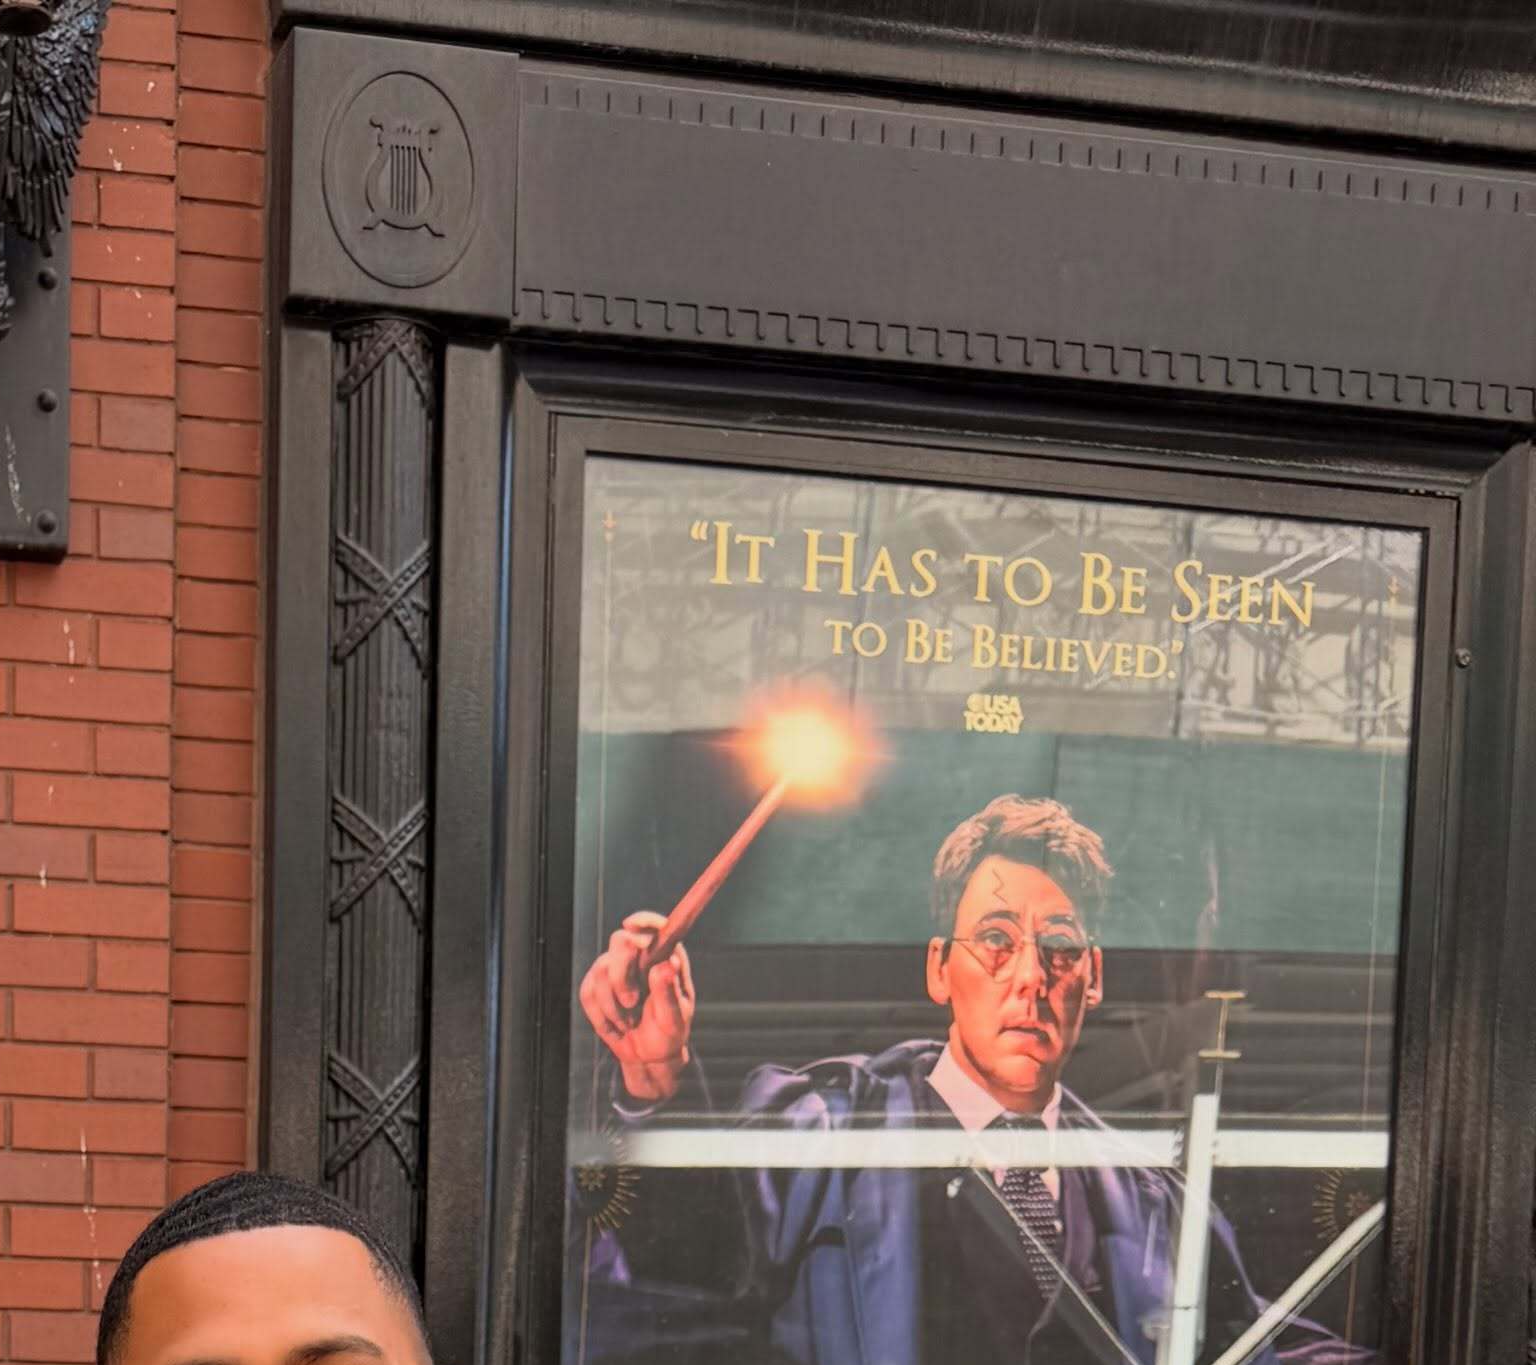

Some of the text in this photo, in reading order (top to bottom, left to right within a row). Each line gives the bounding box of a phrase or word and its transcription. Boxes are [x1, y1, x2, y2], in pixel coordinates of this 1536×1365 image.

[801, 528, 938, 598] HAS
[963, 553, 1053, 606] TO
[1078, 552, 1148, 617] BE
[1170, 560, 1316, 627] SEEN
[824, 618, 888, 657] TO
[904, 618, 953, 663] BE
[983, 694, 1023, 716] USA
[963, 711, 1024, 735] TODAY
